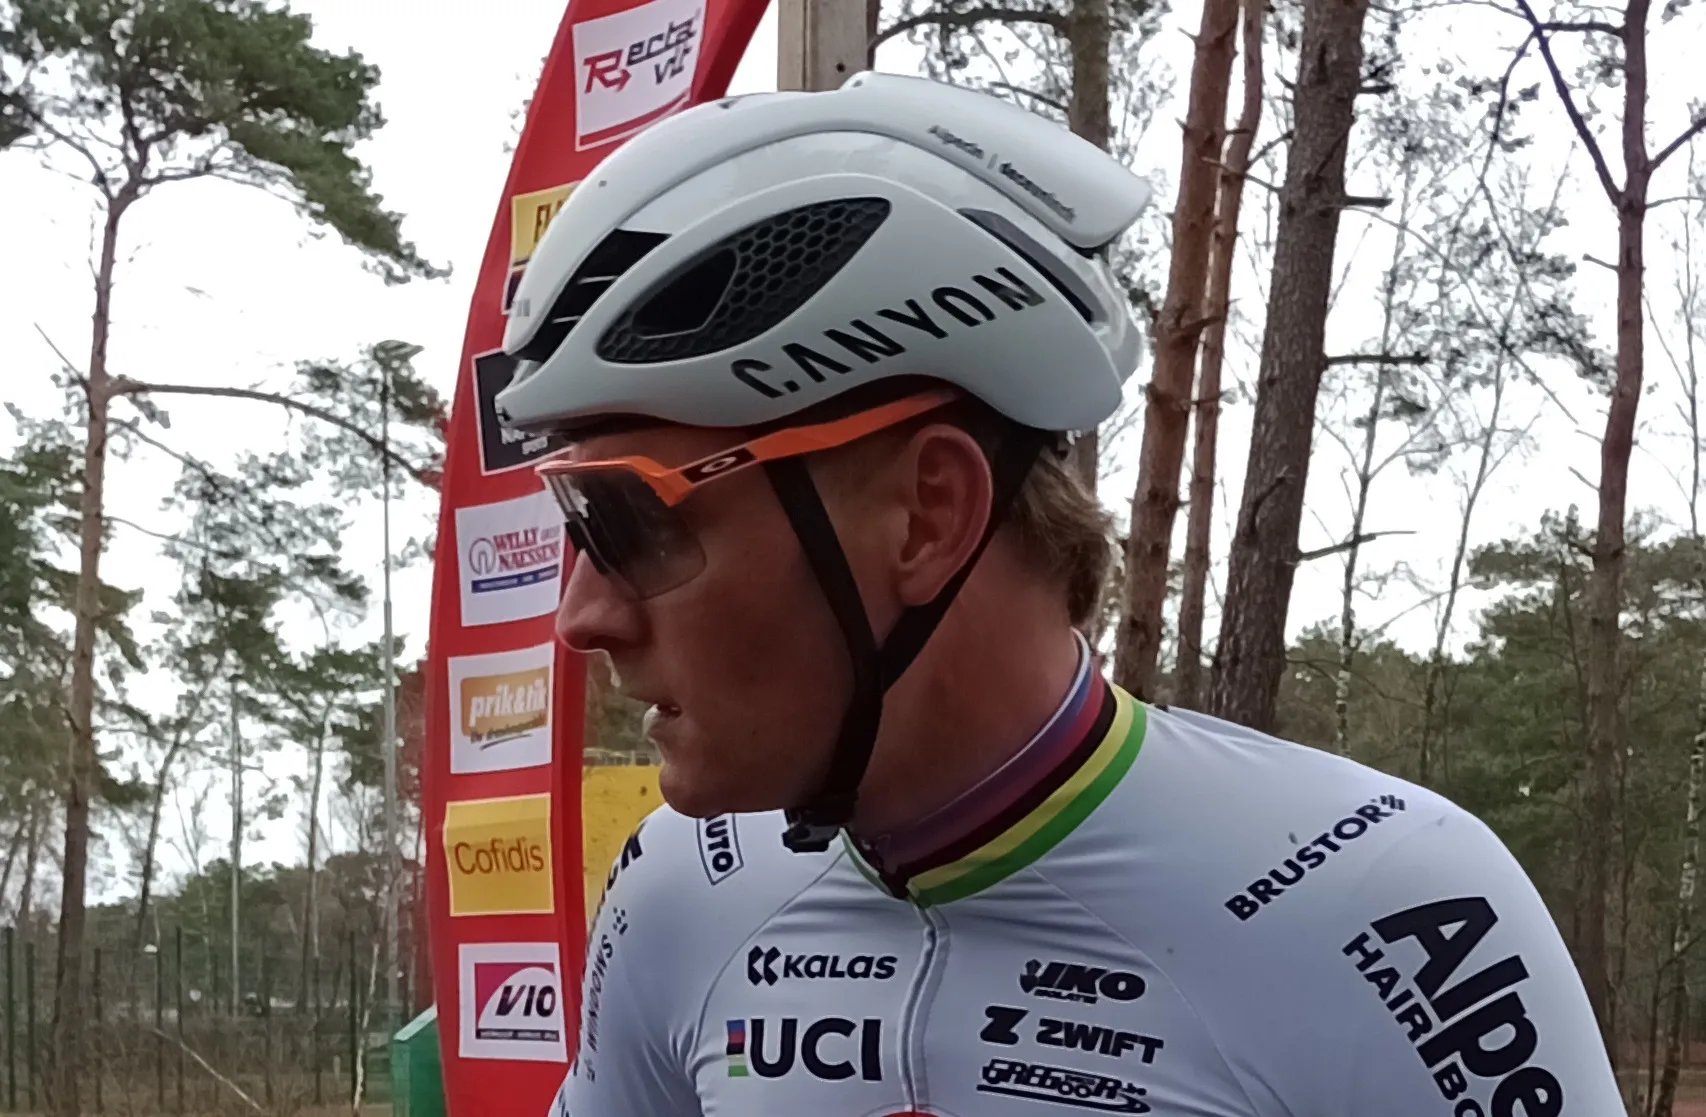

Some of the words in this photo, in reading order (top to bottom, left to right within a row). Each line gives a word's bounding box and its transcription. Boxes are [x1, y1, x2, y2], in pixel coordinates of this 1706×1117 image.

[730, 267, 1045, 398] CANYON
[454, 836, 545, 875] Cofidis
[704, 815, 734, 873] UTO
[1225, 800, 1389, 921] BRUSTOR
[750, 1018, 882, 1081] UCI
[1036, 1018, 1164, 1064] ZWIFT
